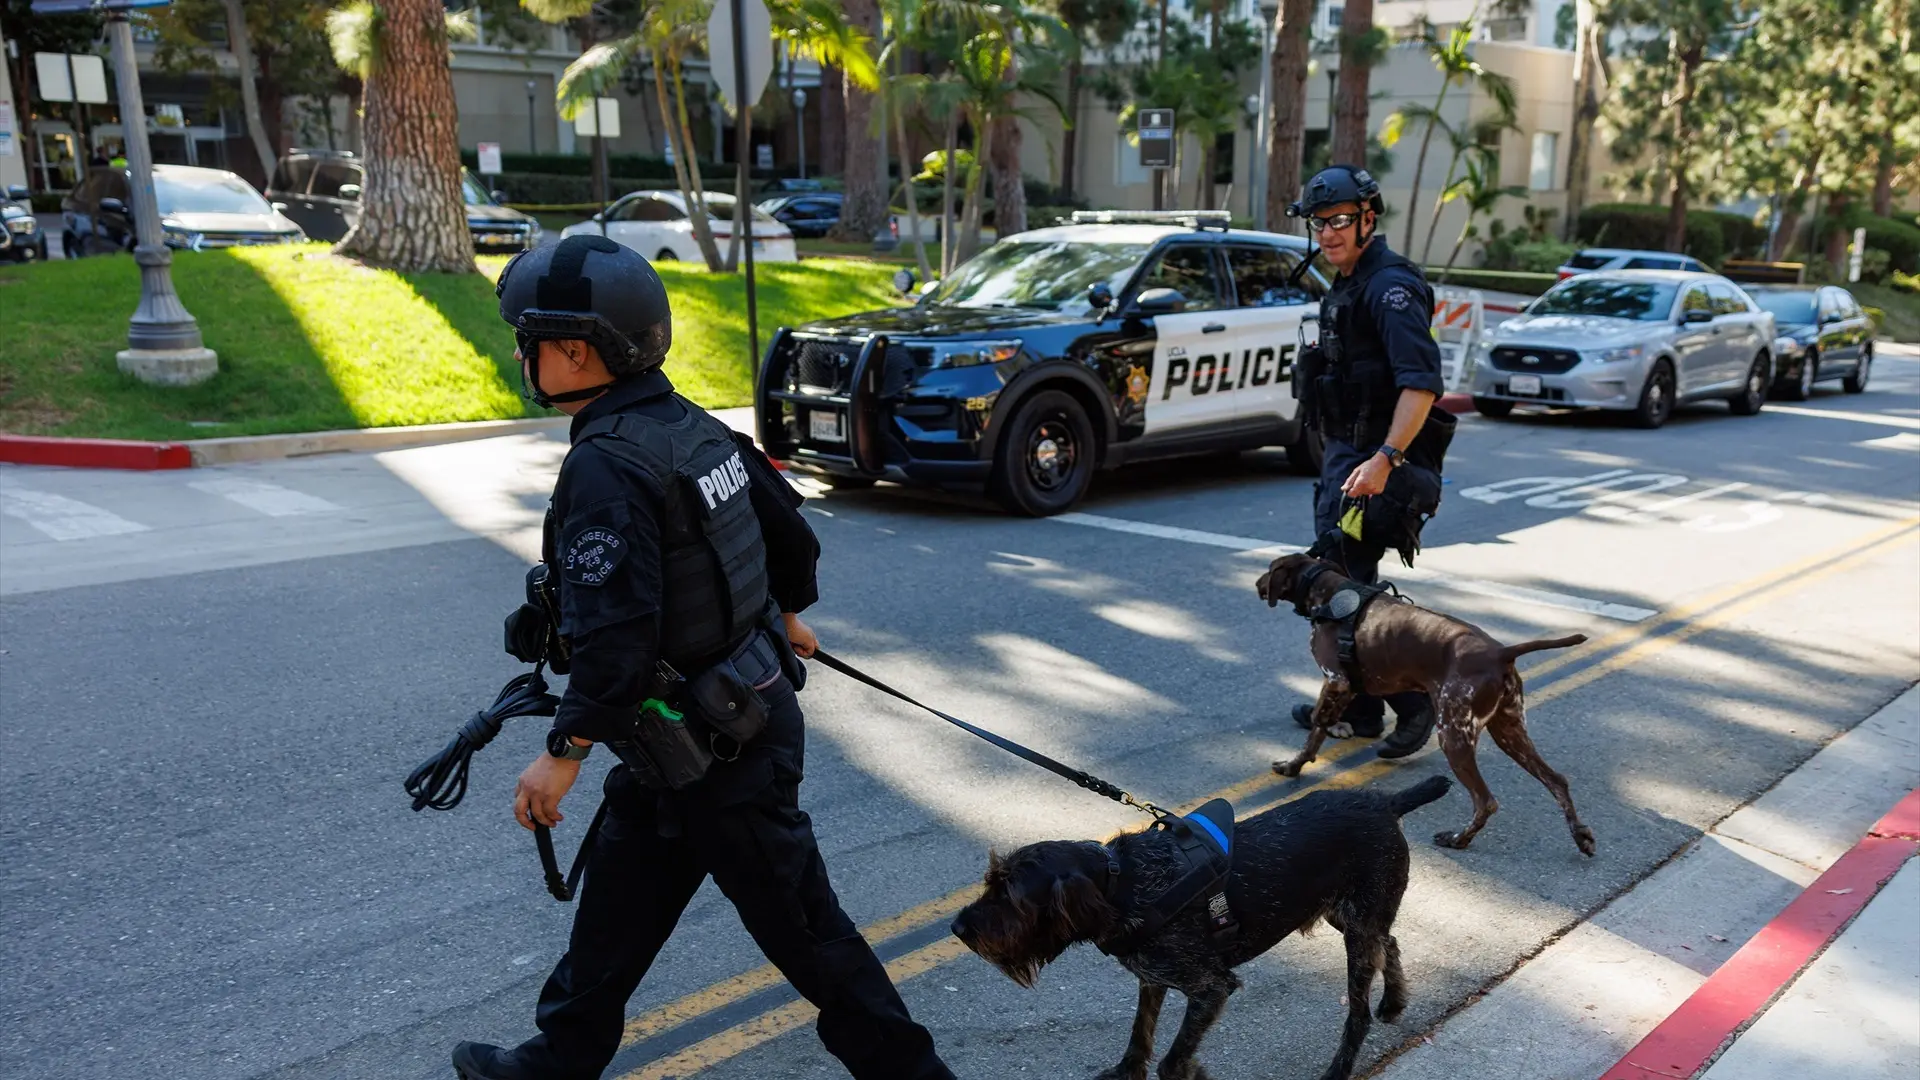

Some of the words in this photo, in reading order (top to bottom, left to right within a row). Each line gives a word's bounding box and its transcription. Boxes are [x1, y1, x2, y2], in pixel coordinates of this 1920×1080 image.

[1167, 346, 1187, 357] UCLA
[1162, 344, 1296, 400] POLICE
[966, 397, 986, 410] 25
[697, 451, 750, 510] POLICE
[566, 547, 578, 570] LOS
[576, 531, 620, 548] ANGELES
[577, 545, 605, 564] BOMB
[582, 560, 614, 582] POLICE
[585, 556, 601, 569] K-9
